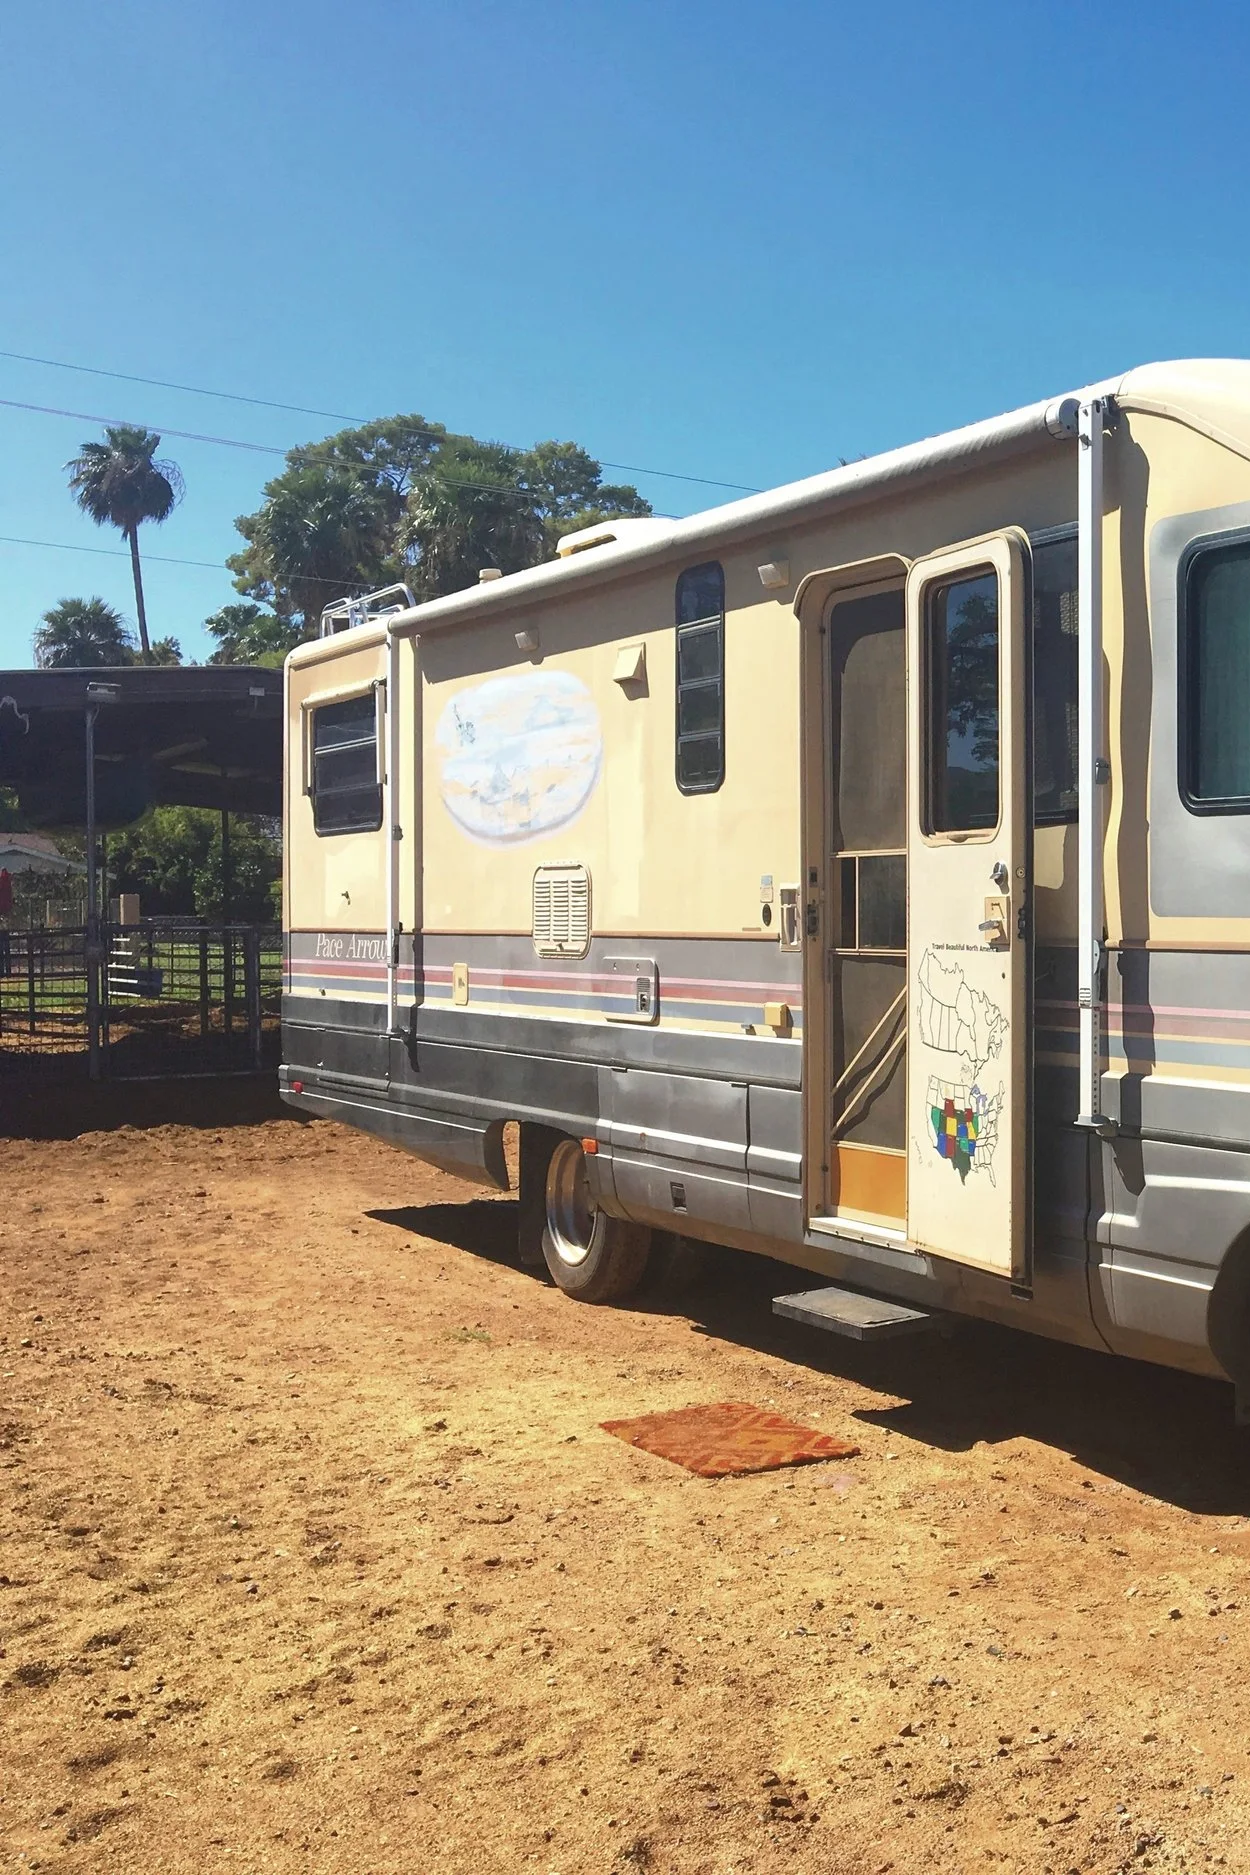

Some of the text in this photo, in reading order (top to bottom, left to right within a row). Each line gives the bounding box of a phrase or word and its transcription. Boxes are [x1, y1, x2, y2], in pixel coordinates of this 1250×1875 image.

[314, 933, 343, 958] Pace
[946, 943, 965, 951] Beautiful
[966, 944, 979, 952] North
